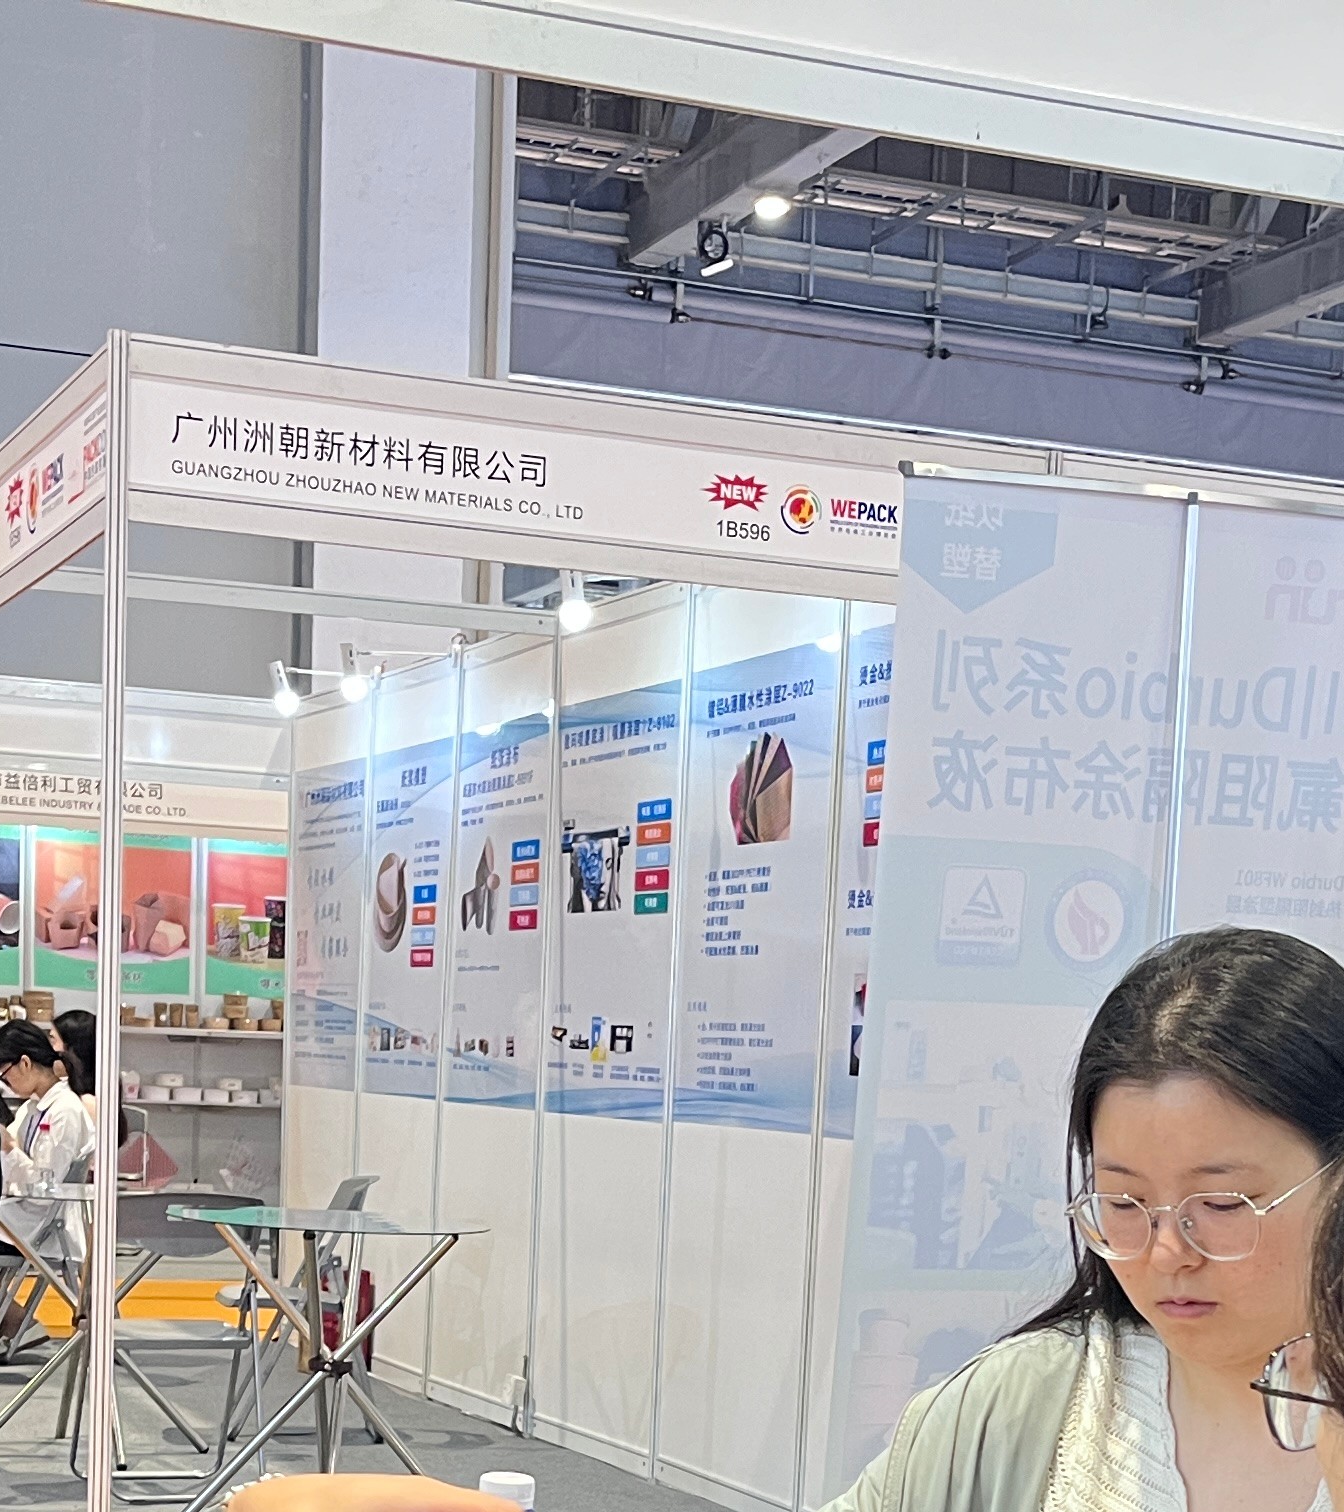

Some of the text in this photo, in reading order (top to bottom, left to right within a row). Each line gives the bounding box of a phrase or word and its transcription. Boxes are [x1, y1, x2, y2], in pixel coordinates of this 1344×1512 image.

[171, 411, 548, 488] 广州洲朝新材料有限公司
[171, 459, 280, 487] GUANGZHOU
[286, 472, 377, 497] ZHOUZHAO
[383, 484, 419, 502] NEW
[425, 488, 513, 513] MATERIALS
[556, 505, 584, 521] LTD
[720, 483, 757, 501] NEW
[830, 498, 898, 525] WEPACK
[716, 520, 771, 542] 1B596
[39, 798, 94, 812] INDUSTRY
